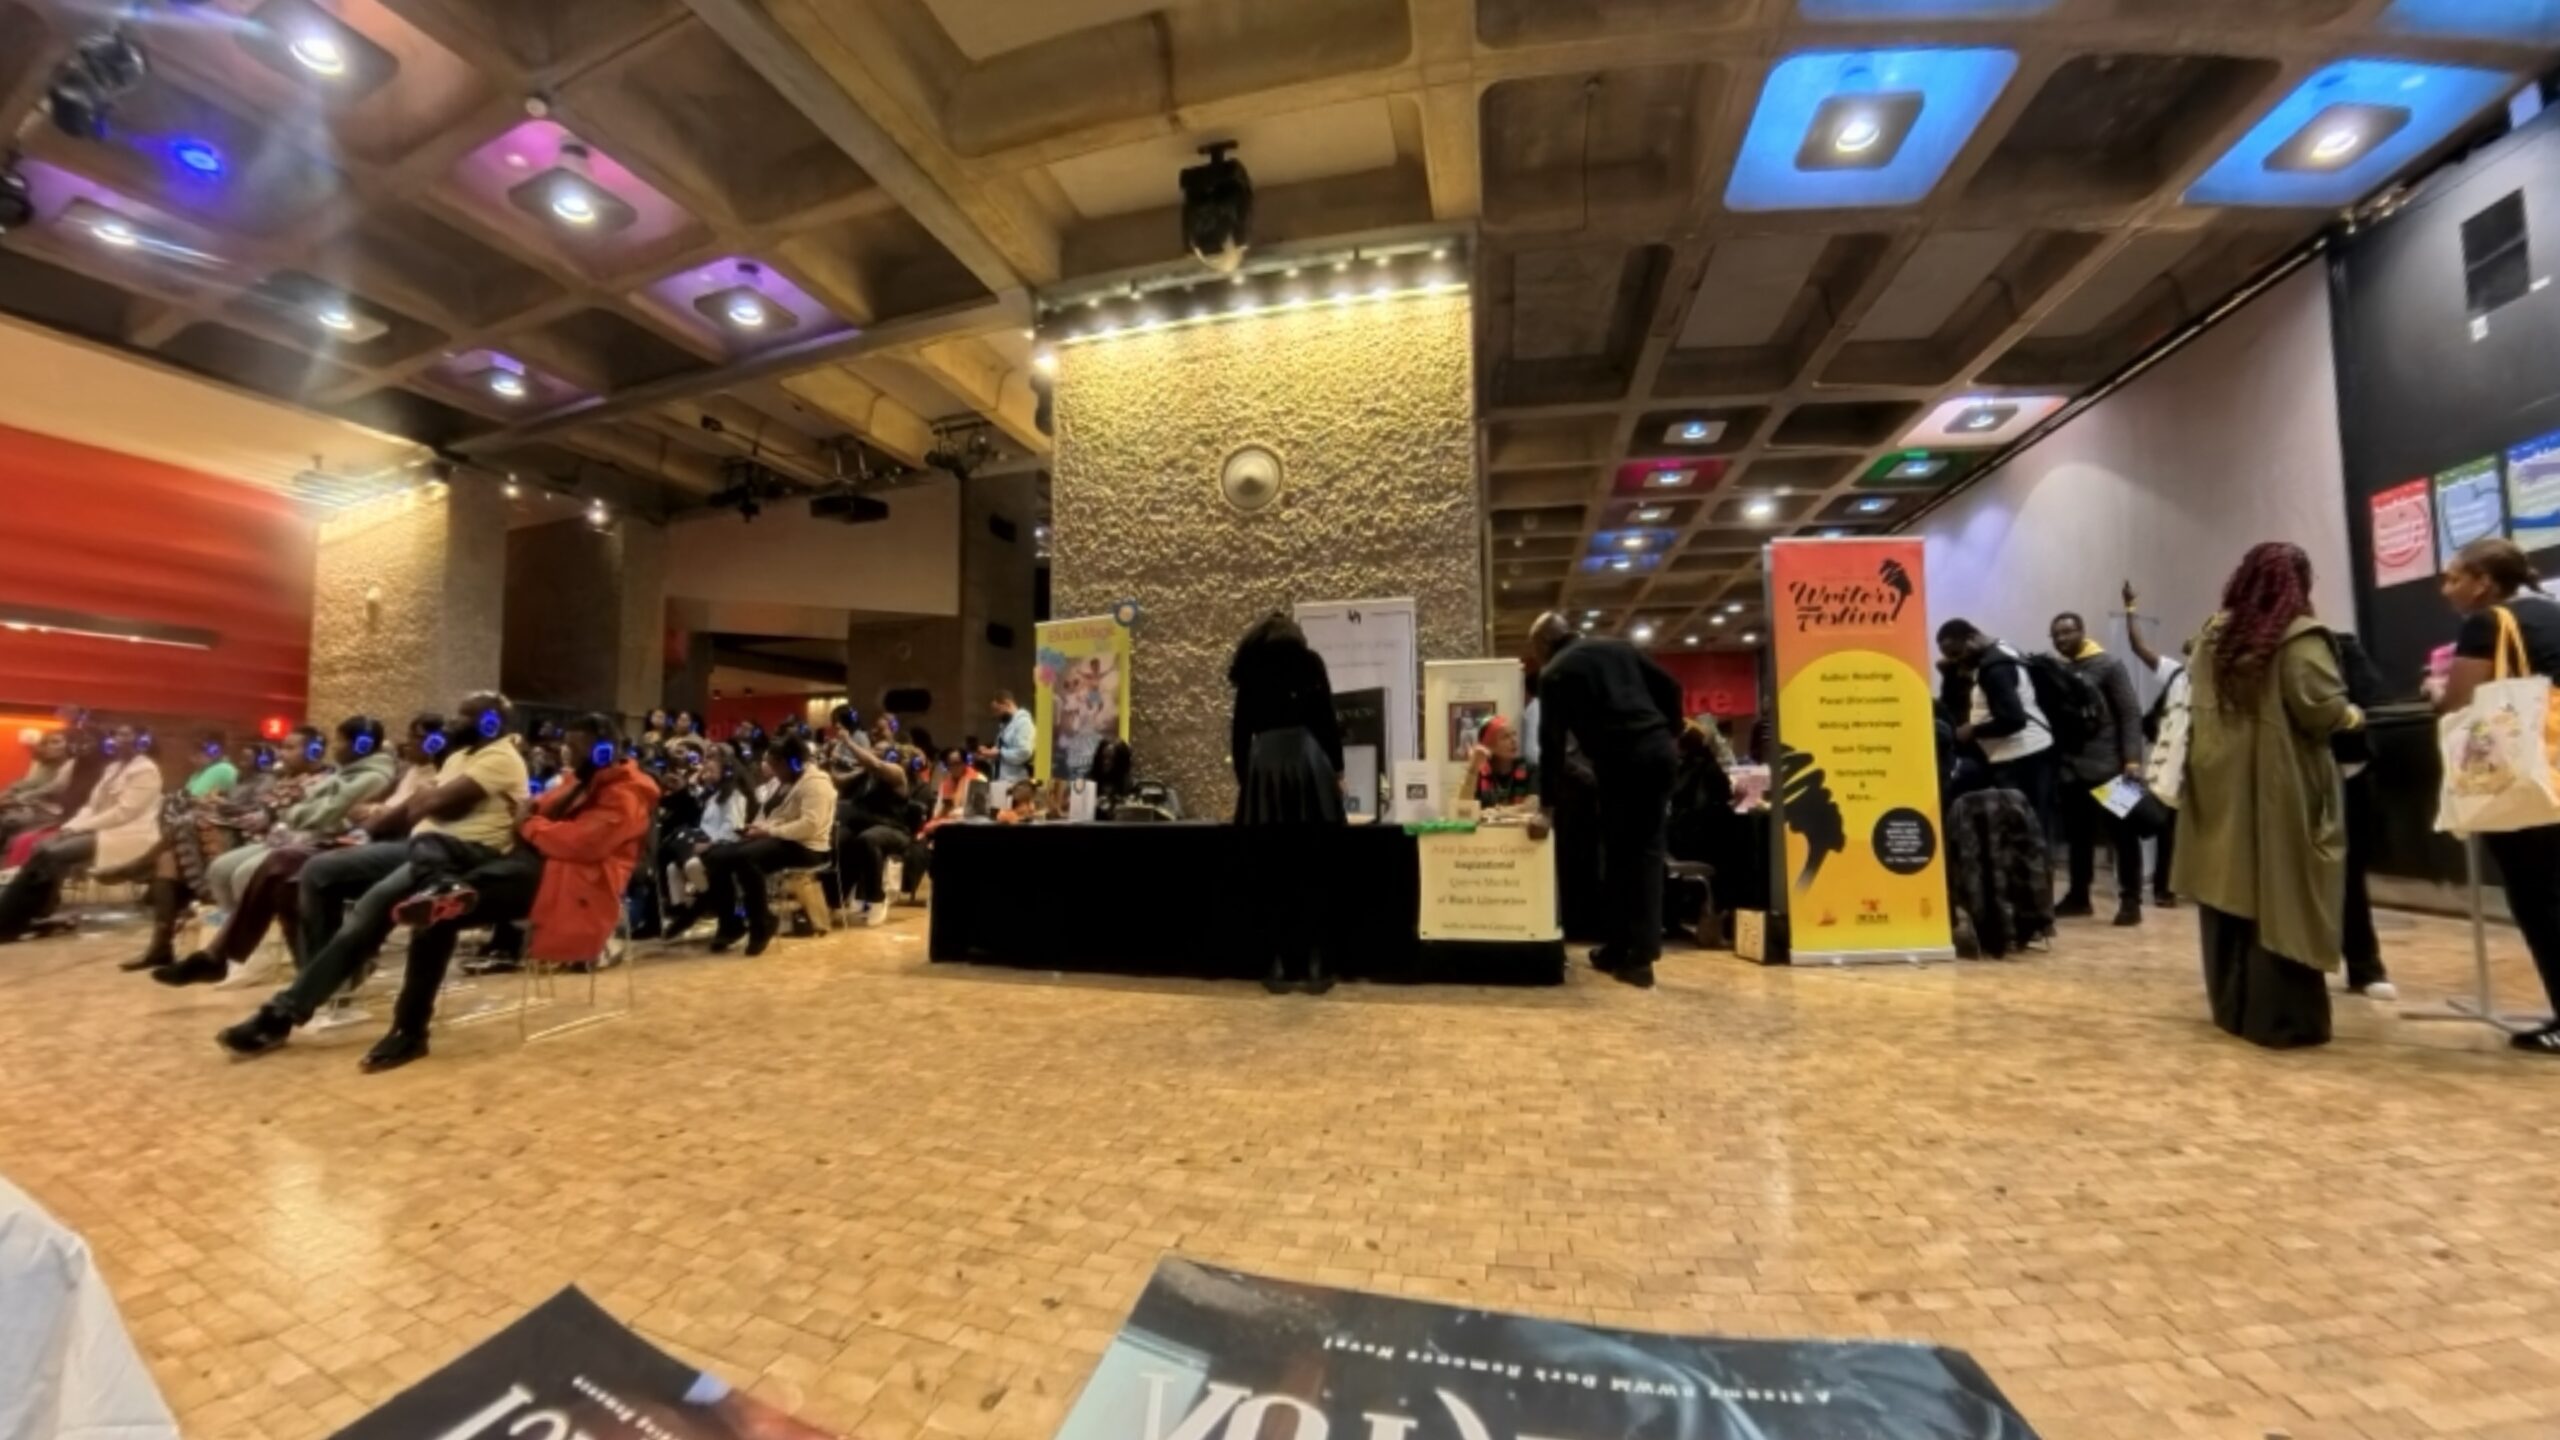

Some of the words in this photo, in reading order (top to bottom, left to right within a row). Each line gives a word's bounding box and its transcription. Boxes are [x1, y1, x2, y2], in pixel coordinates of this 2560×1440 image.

[1796, 604, 1899, 633] Festival
[1820, 672, 1849, 682] Author
[1852, 671, 1894, 682] Readings
[1819, 695, 1844, 705] Panel
[1846, 695, 1900, 705] Discussions
[1818, 720, 1849, 730] Writing
[1851, 719, 1902, 730] Workshops
[1857, 744, 1892, 755] Signing
[1834, 768, 1887, 779] Networking
[1448, 895, 1474, 905] Black
[1476, 895, 1528, 906] Liberation
[1322, 1335, 1394, 1360] Novel
[1406, 1350, 1523, 1378] Romance
[1533, 1365, 1598, 1390] Dark
